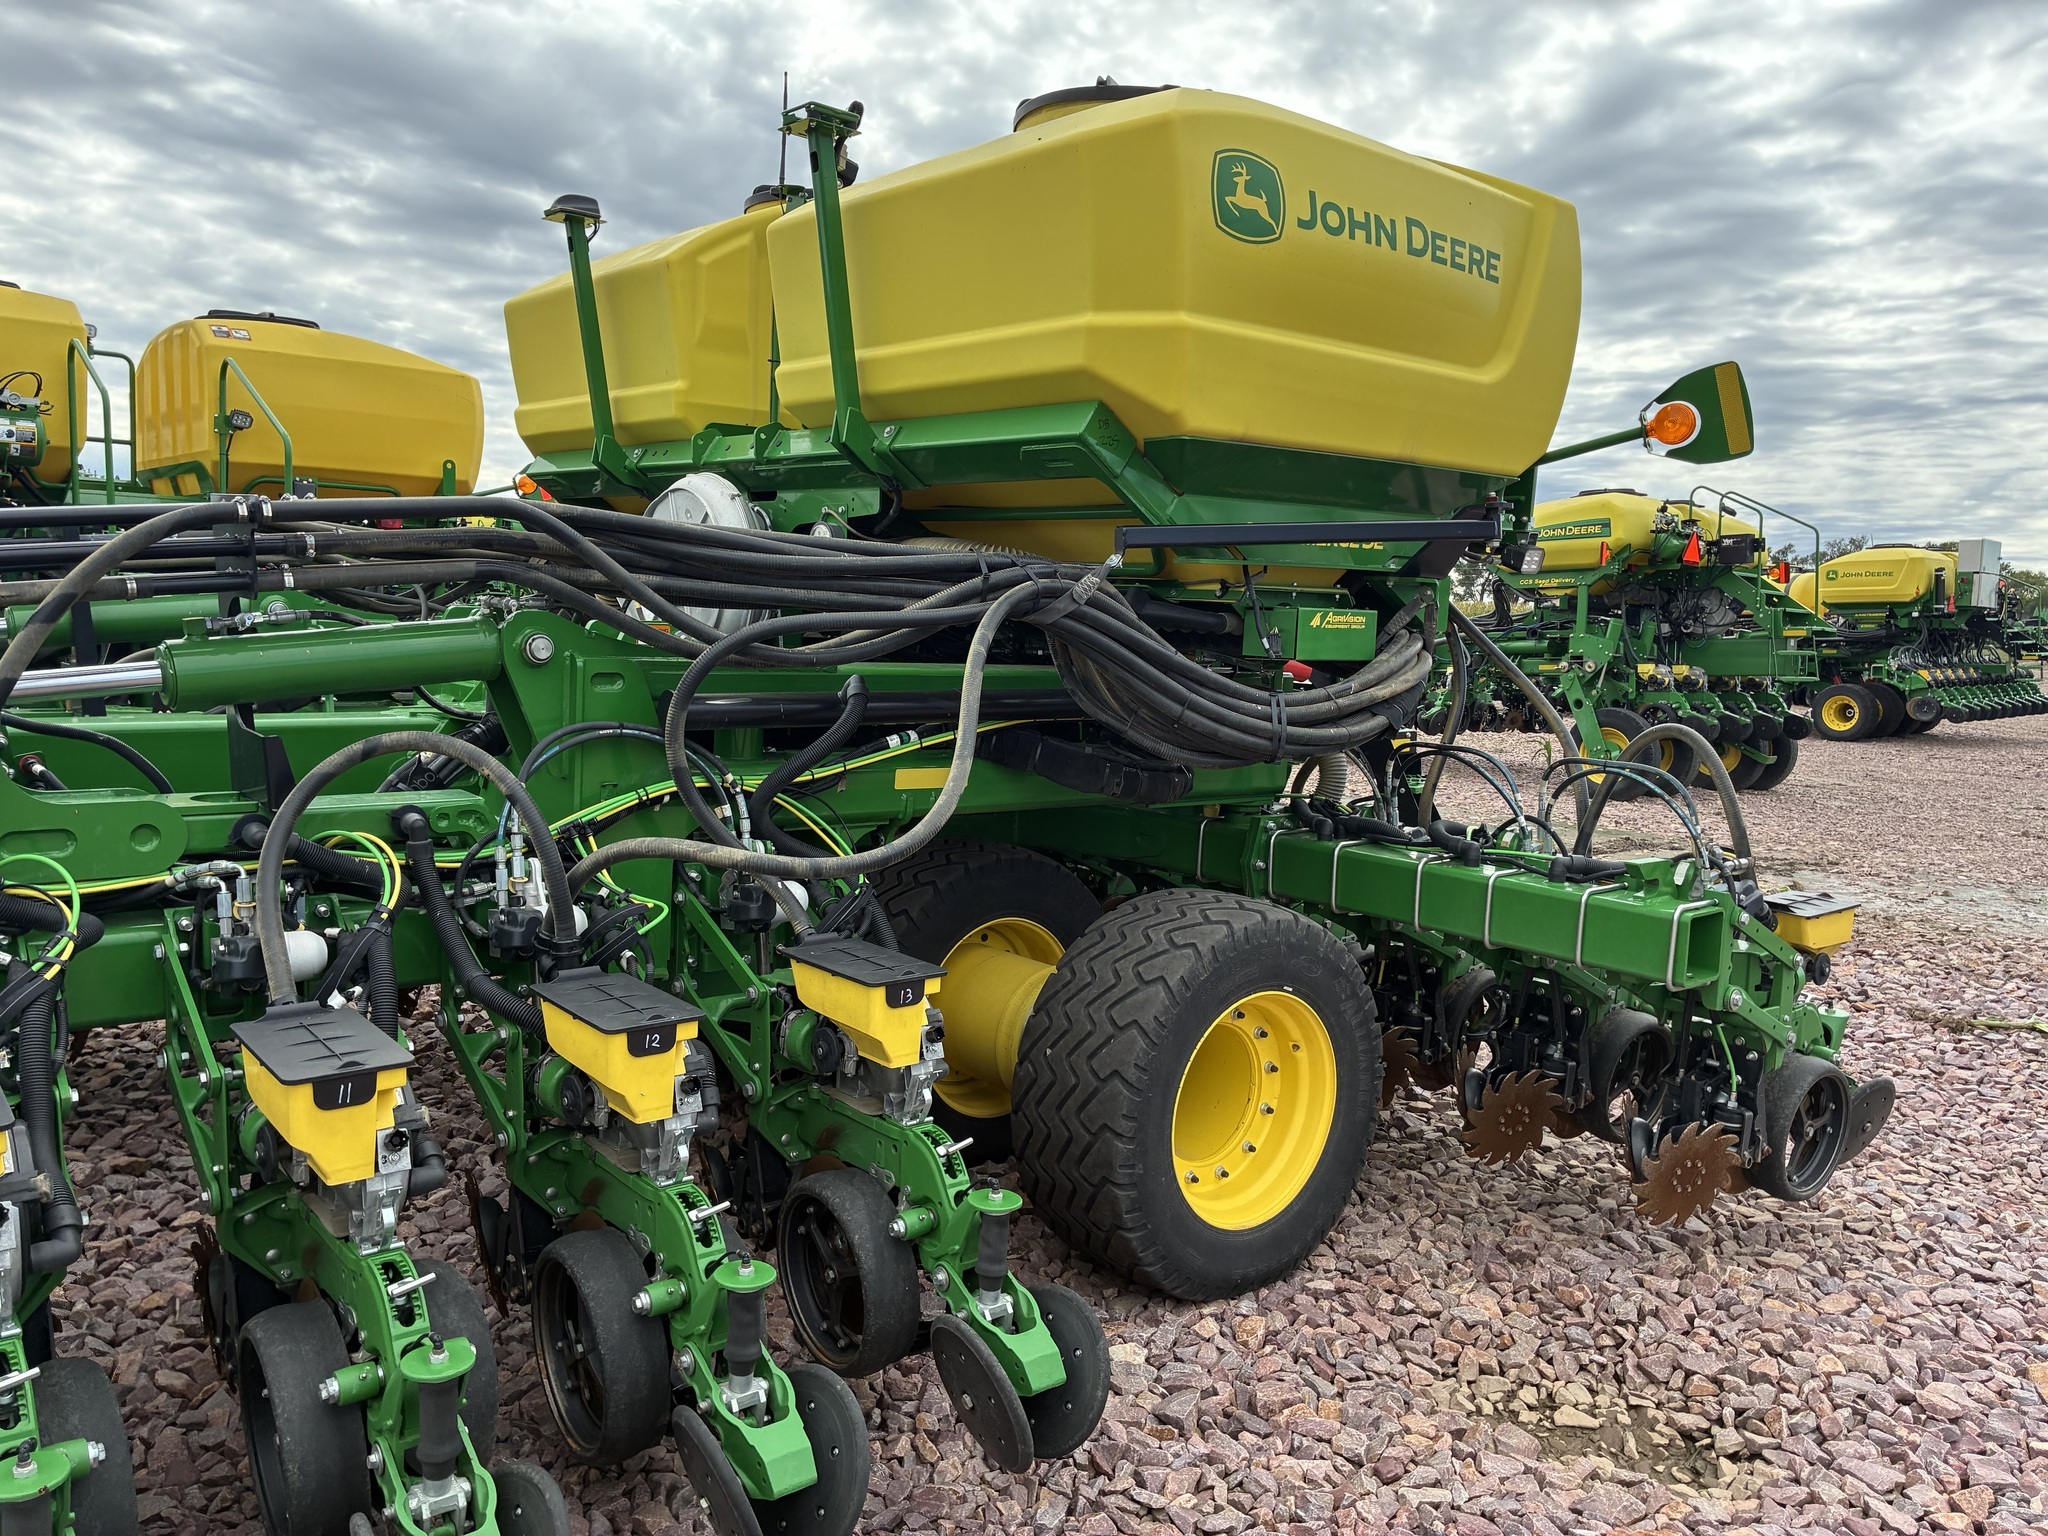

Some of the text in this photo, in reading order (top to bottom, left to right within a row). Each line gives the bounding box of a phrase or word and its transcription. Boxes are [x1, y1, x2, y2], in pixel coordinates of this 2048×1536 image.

[1297, 190, 1501, 284] JOHN DEERE
[1538, 525, 1602, 538] JOHN DEERE
[899, 988, 913, 1003] 13
[644, 1033, 661, 1049] 12
[338, 1082, 352, 1104] 11
